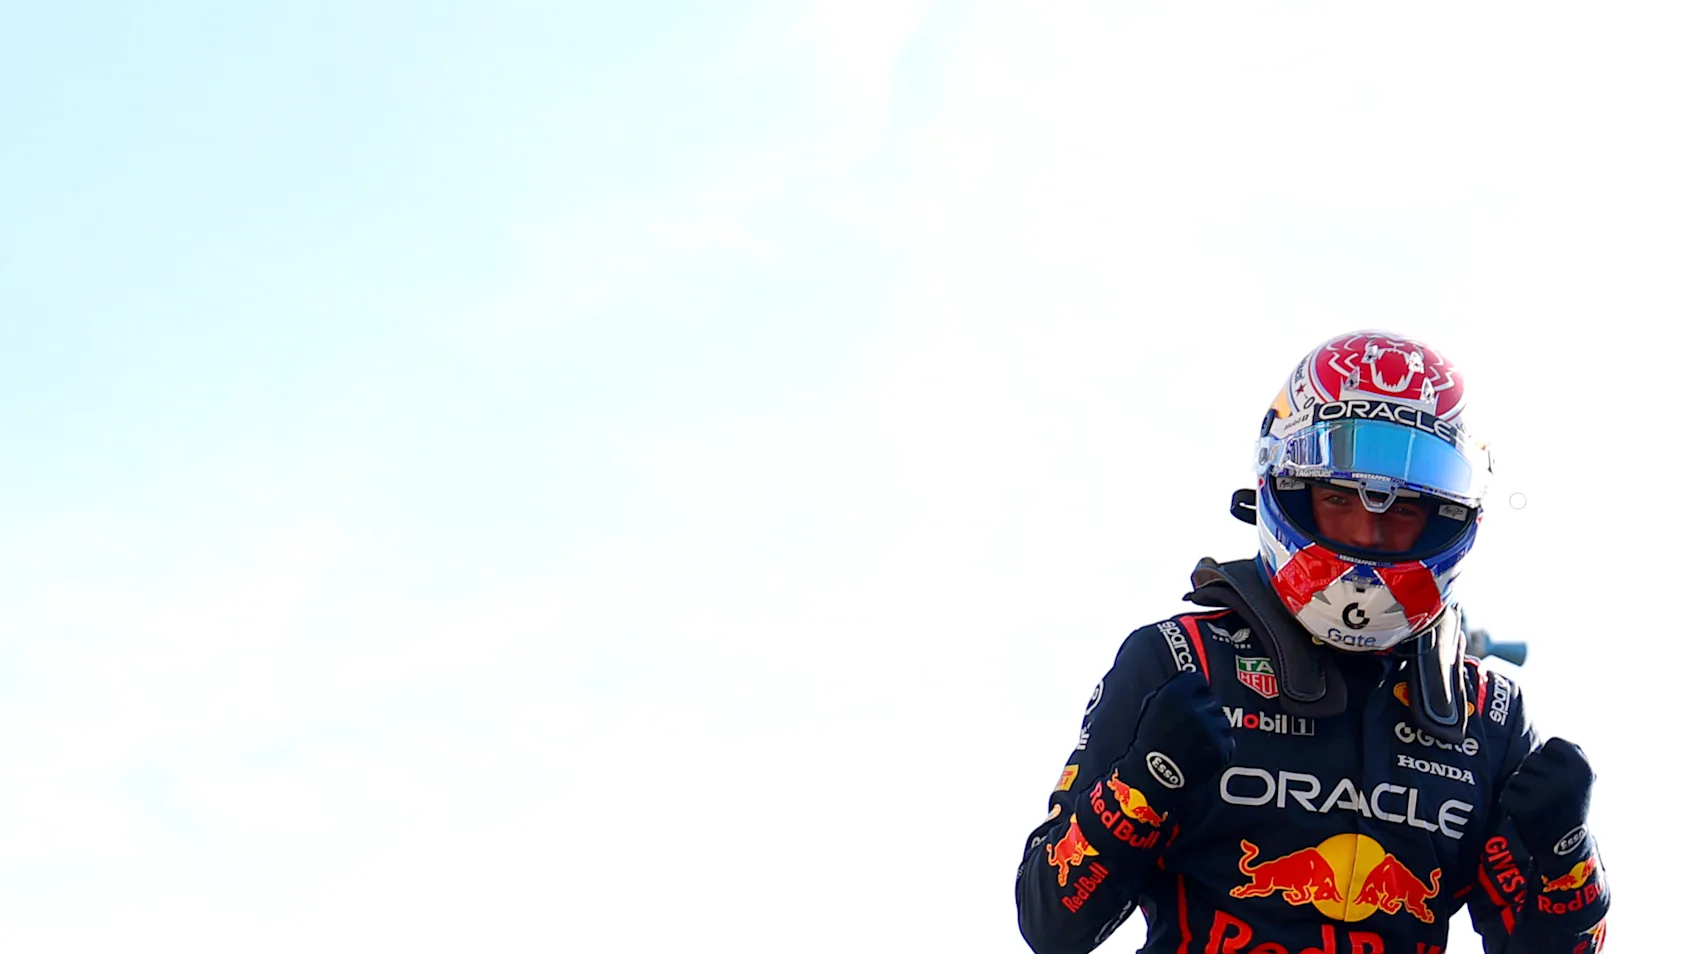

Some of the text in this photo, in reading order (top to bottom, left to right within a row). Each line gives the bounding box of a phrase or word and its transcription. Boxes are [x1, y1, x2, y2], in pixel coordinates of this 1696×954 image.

[1319, 401, 1451, 441] ORACLE
[1327, 627, 1377, 648] Gate
[1240, 660, 1275, 674] TA
[1240, 672, 1279, 696] HEU
[1222, 706, 1288, 734] Mobil
[1396, 754, 1476, 786] HONDA
[1090, 781, 1122, 830] Red
[1219, 766, 1474, 840] ORACLE
[1537, 889, 1583, 915] Red
